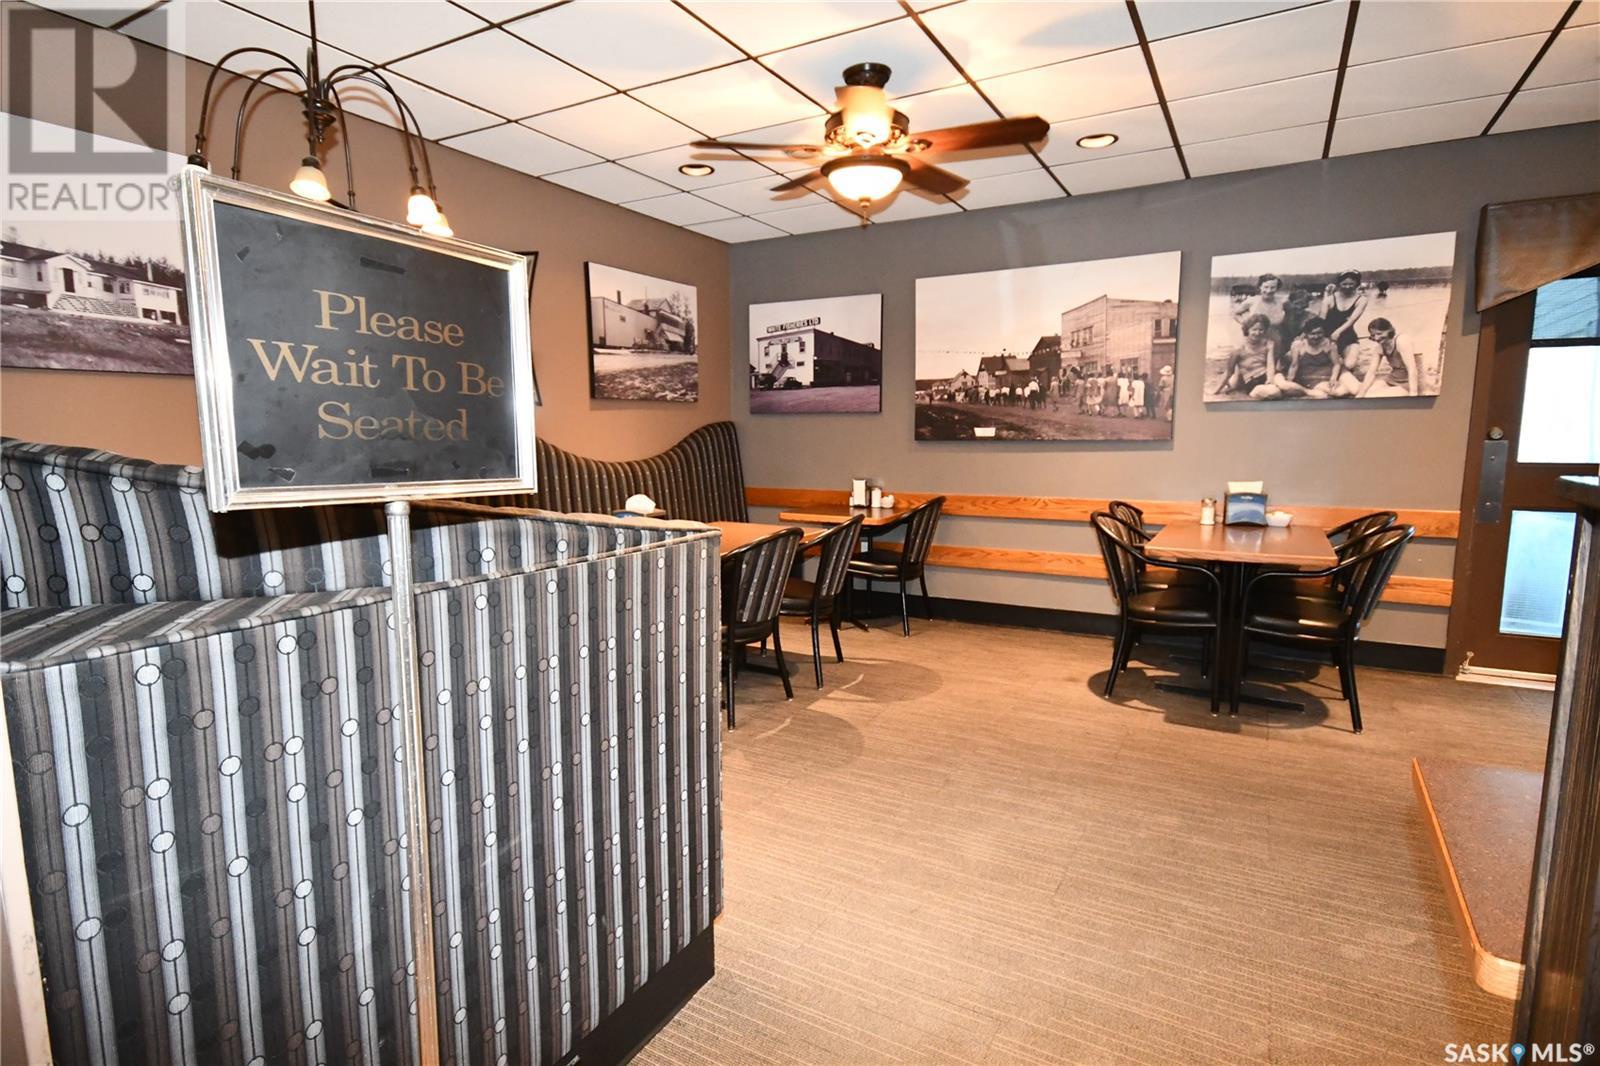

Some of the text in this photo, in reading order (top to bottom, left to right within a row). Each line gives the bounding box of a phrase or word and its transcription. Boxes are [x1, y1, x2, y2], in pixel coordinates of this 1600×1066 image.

[312, 289, 465, 347] Please
[246, 337, 505, 399] Wait To Be
[317, 401, 469, 441] Seated
